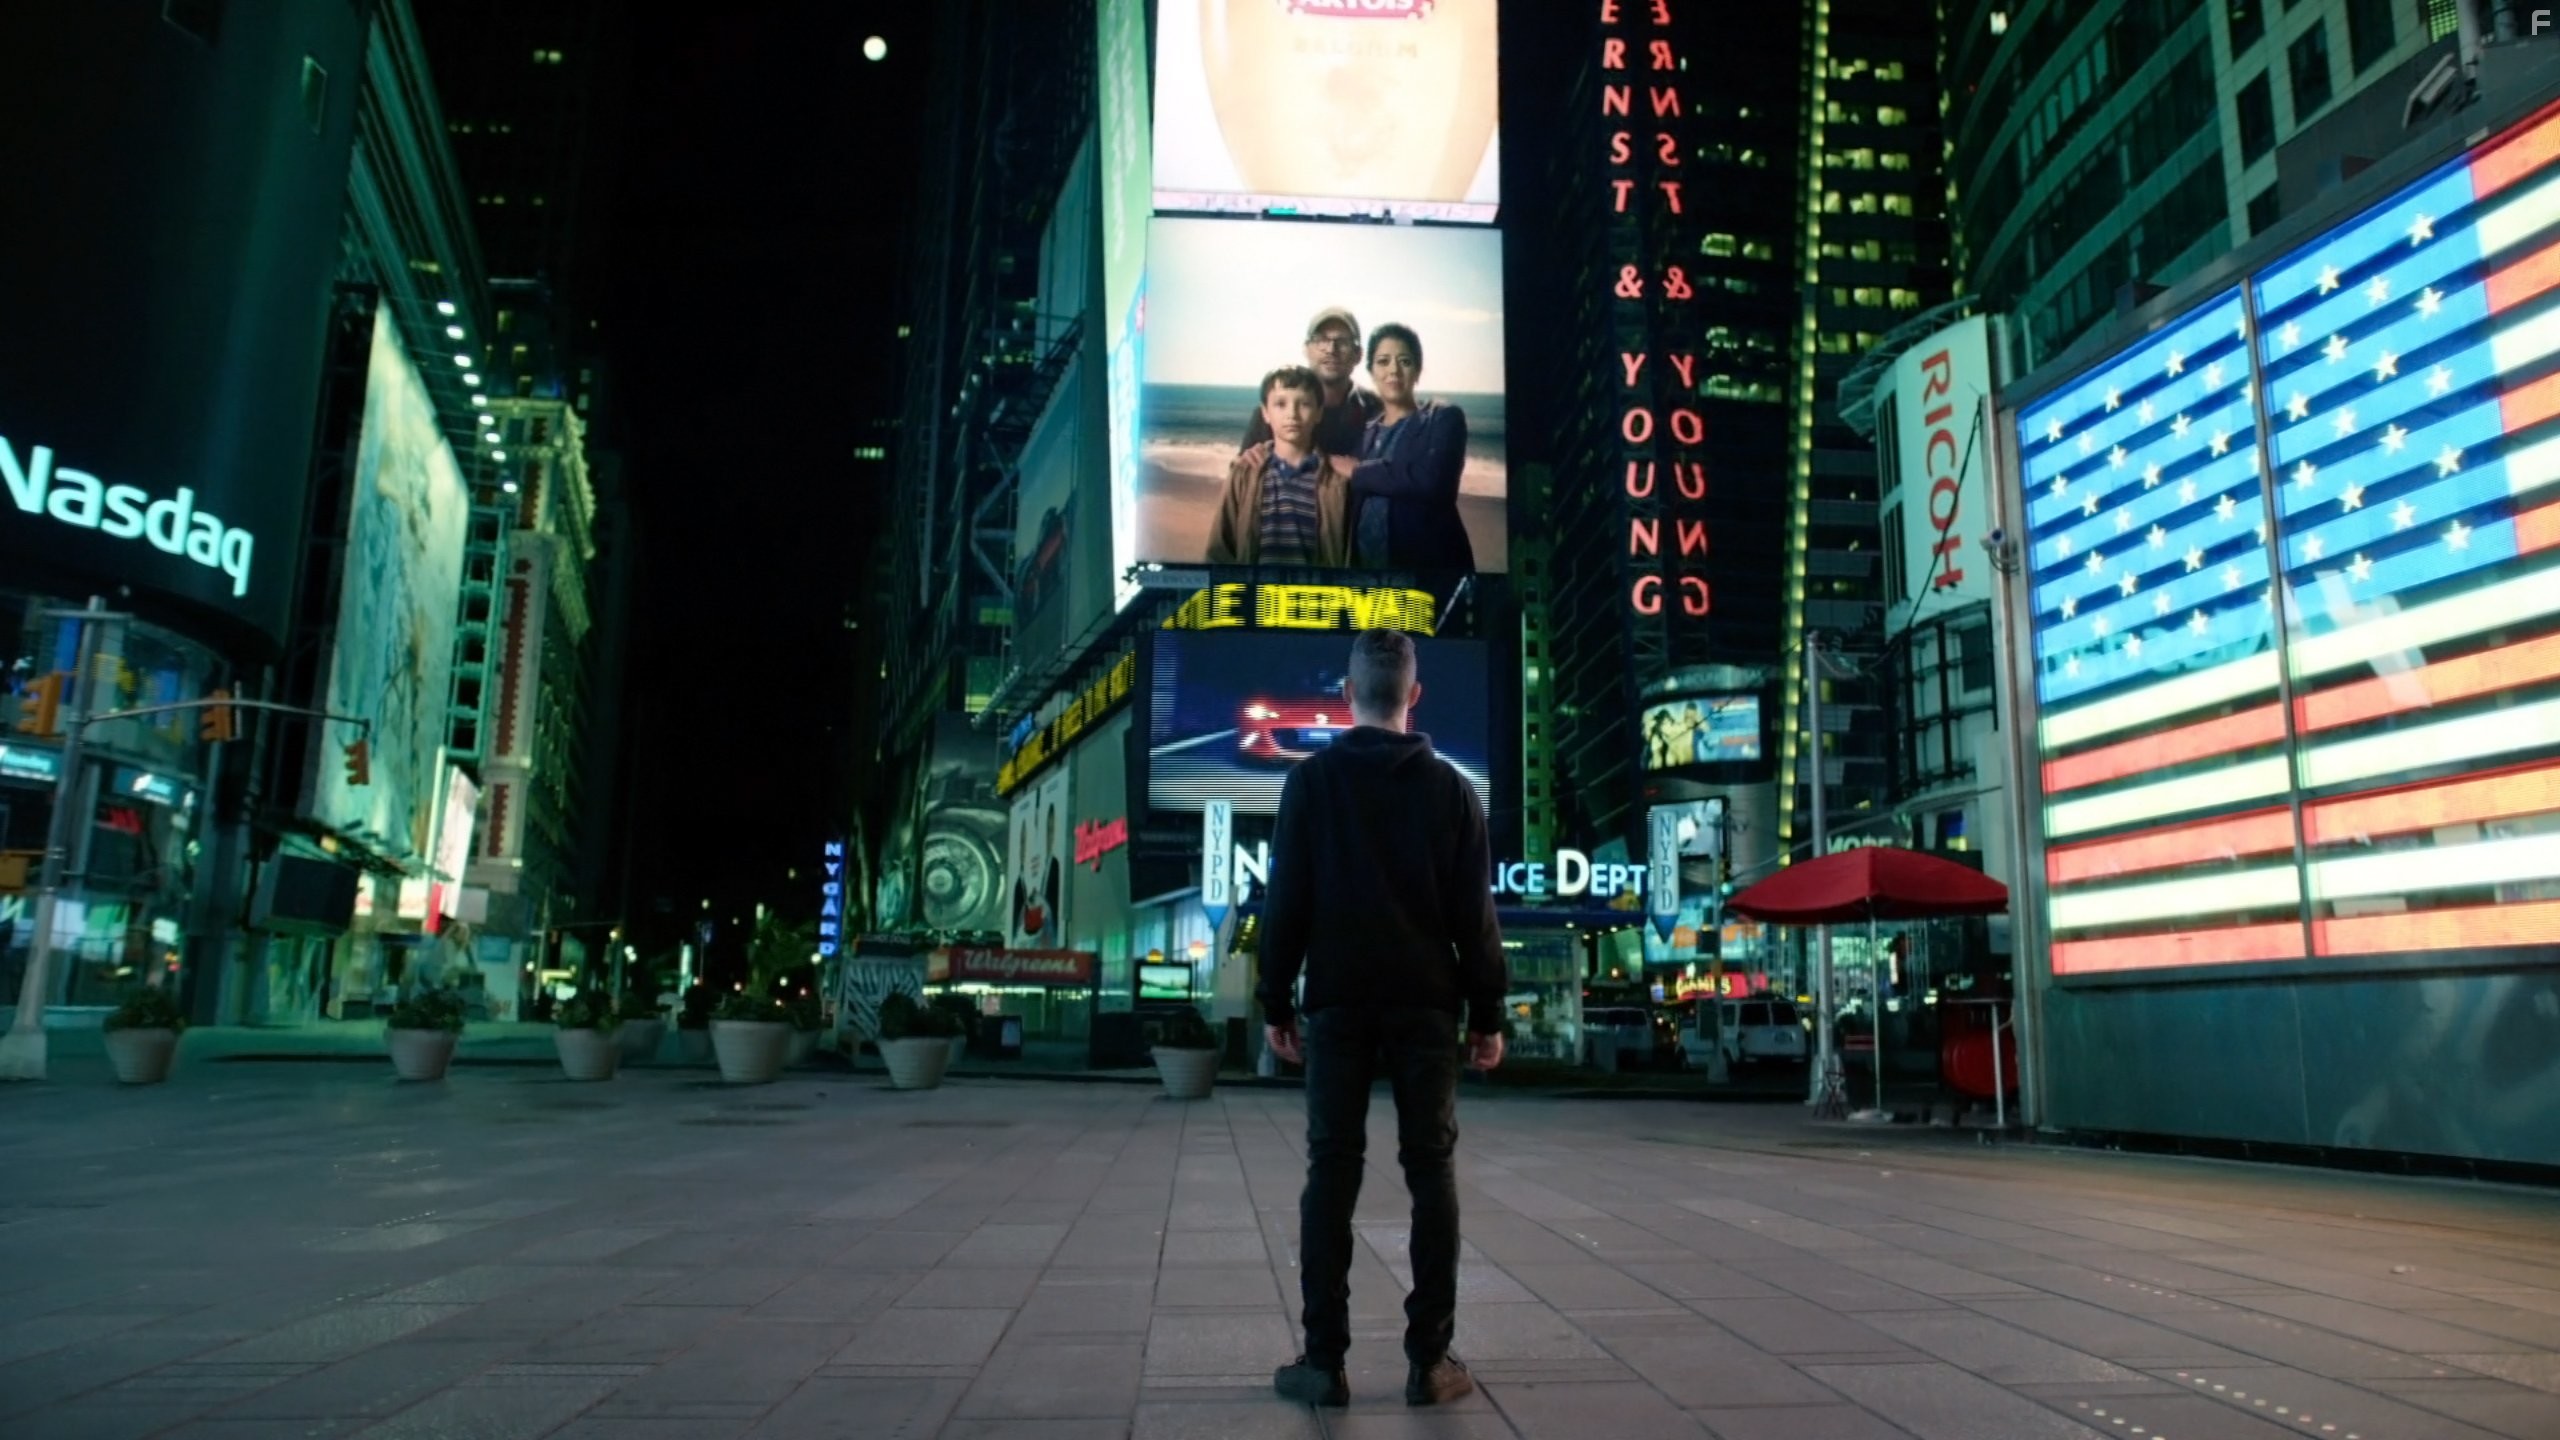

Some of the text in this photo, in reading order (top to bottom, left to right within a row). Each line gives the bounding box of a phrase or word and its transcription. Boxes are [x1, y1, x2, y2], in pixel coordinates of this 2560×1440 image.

[1601, 0, 1662, 615] ERNST & YOUNG
[0, 436, 253, 597] Nasdaq
[1922, 349, 1963, 588] RICOH
[1211, 804, 1224, 900] NYPD
[1660, 816, 1672, 911] NYPD
[964, 950, 1077, 978] Walgreens
